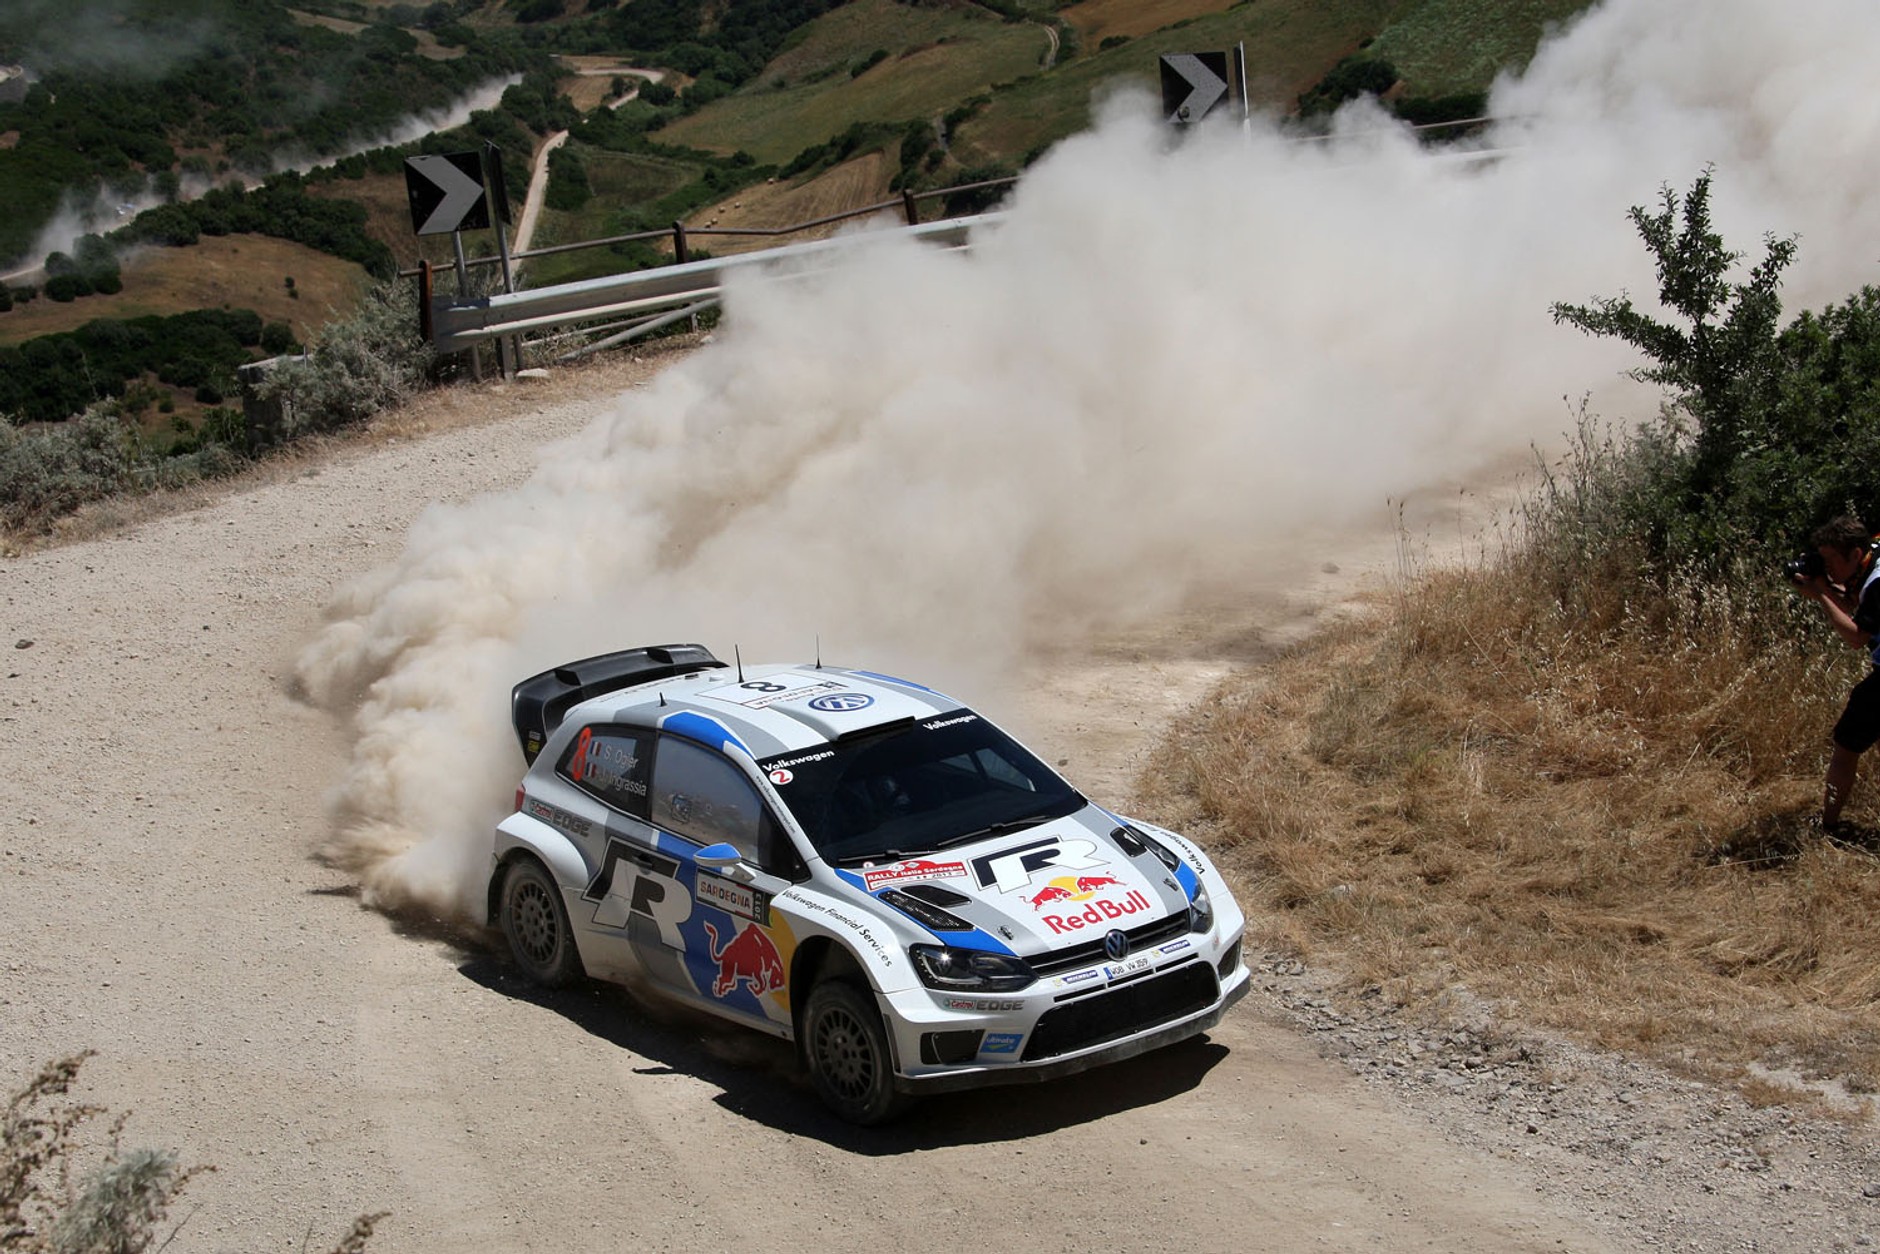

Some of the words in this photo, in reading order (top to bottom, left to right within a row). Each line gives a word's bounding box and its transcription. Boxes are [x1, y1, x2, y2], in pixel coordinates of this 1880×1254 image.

[740, 681, 787, 693] 8
[923, 714, 977, 730] Volkswagen
[573, 727, 593, 782] 8
[604, 744, 613, 761] S.
[615, 749, 639, 769] Ogier
[762, 750, 835, 772] Volkswagen
[772, 771, 790, 783] 2
[552, 808, 593, 838] EDGE
[867, 871, 898, 881] RALLY
[923, 865, 963, 874] Sardegna
[581, 836, 693, 953] R
[700, 880, 751, 910] SARDEGNA
[1042, 903, 1104, 935] Red
[1095, 889, 1151, 919] Bull
[782, 889, 826, 913] Volkswagen
[824, 908, 864, 931] Financial
[858, 928, 893, 968] Services
[976, 1000, 1024, 1011] EDGE
